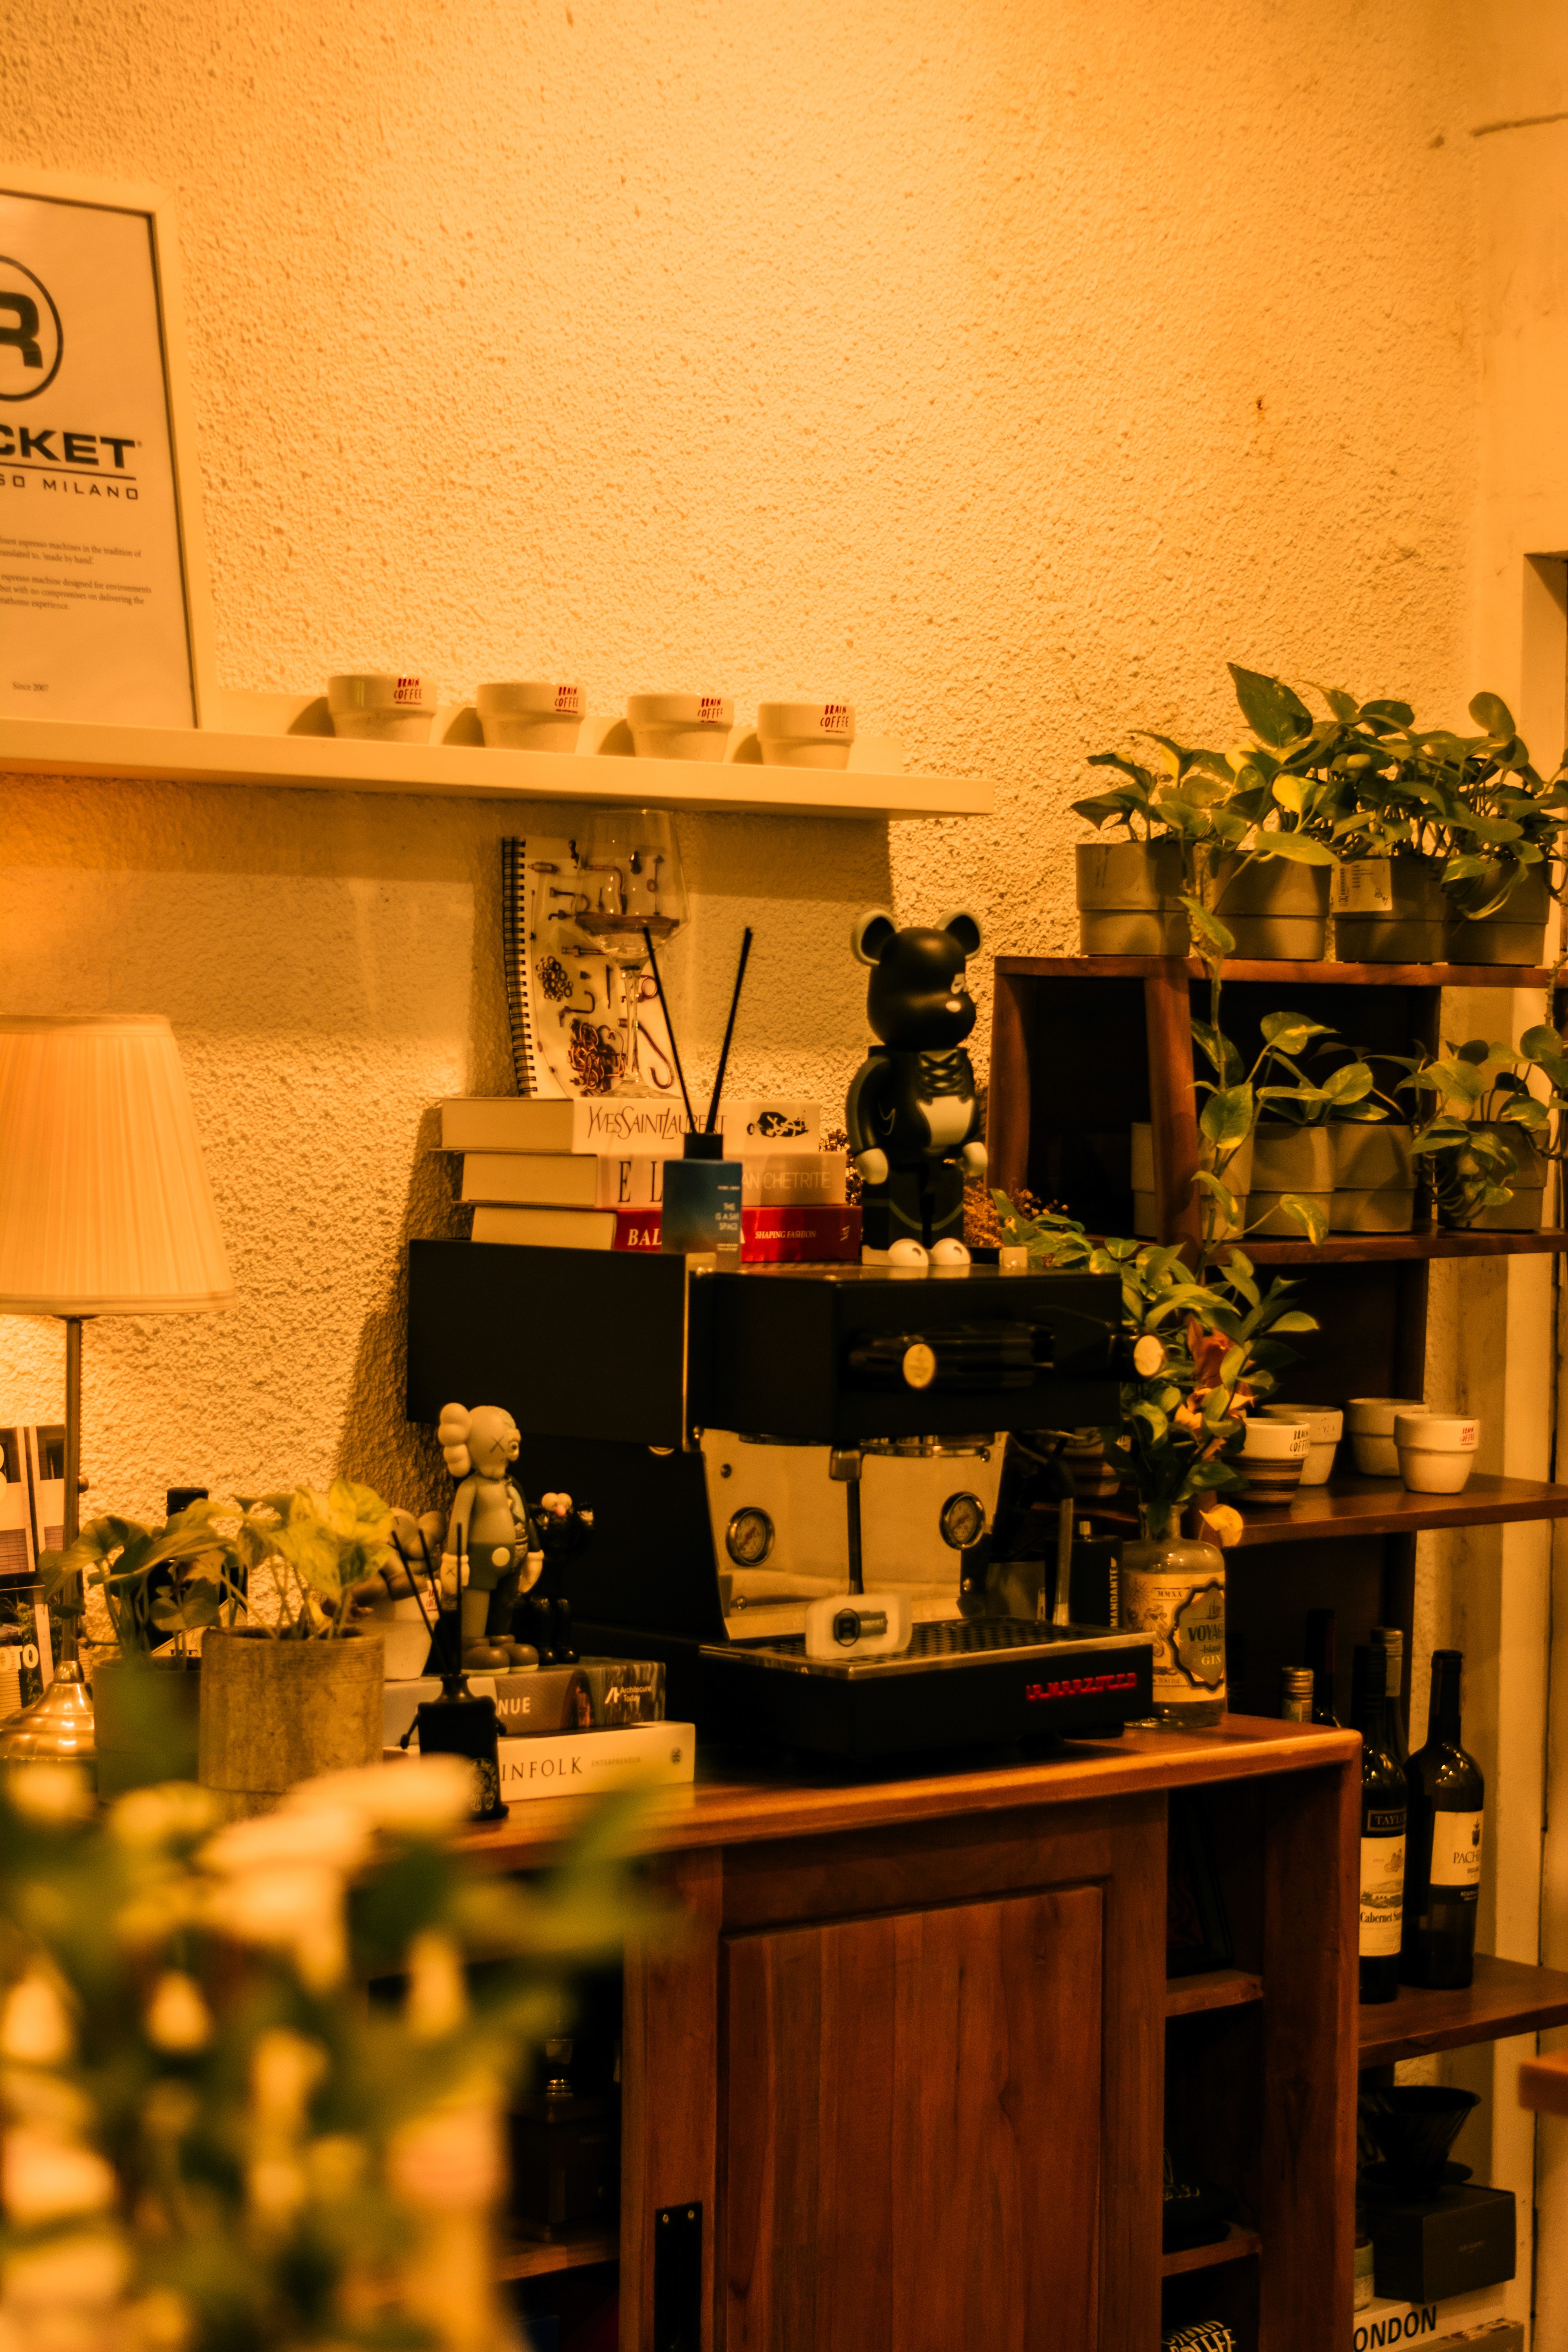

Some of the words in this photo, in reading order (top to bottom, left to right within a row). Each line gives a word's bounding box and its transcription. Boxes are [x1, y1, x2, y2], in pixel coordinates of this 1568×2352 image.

[43, 478, 138, 504] MILANO
[19, 540, 47, 548] espresso
[49, 542, 81, 551] machines
[83, 544, 90, 553] in
[91, 544, 102, 554] the
[103, 547, 132, 557] tradition
[64, 554, 73, 565] by
[1, 574, 30, 583] espresso
[32, 576, 61, 585] machine
[62, 578, 93, 590] designed
[94, 580, 104, 589] for
[106, 583, 152, 594] environments
[13, 586, 29, 594] with
[42, 590, 87, 599] compromises
[99, 592, 132, 606] delivering
[134, 596, 145, 605] the
[12, 682, 31, 691] Since
[33, 683, 49, 692] 2007
[394, 688, 422, 700] COFFEE
[555, 697, 579, 708] COFFEE
[698, 708, 723, 719] COFFEE
[820, 716, 849, 728] COFFEE
[764, 1171, 831, 1189] CHETRITE
[755, 1230, 786, 1239] SHAPING
[787, 1230, 817, 1238] FASHION
[1201, 1654, 1221, 1665] GIN
[502, 1757, 583, 1781] INFOLK
[1360, 1911, 1392, 1923] Cabernet
[1354, 2305, 1436, 2352] ONDON
